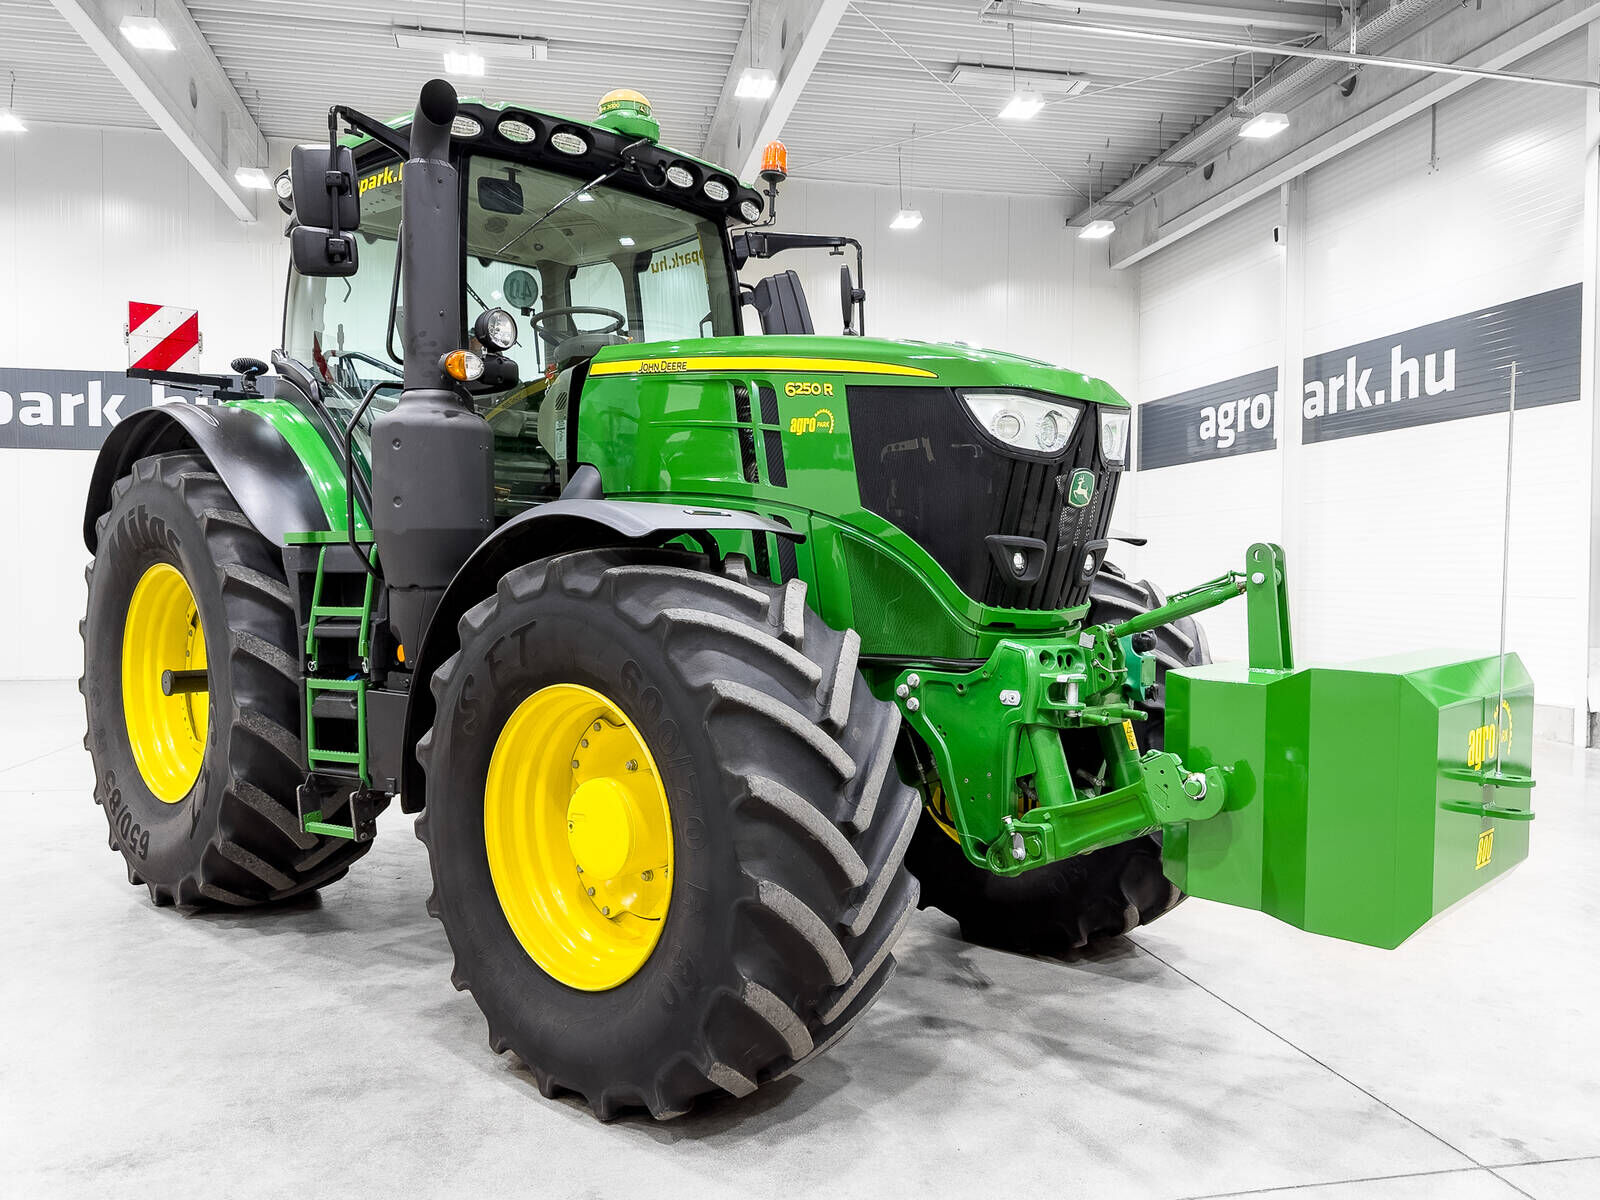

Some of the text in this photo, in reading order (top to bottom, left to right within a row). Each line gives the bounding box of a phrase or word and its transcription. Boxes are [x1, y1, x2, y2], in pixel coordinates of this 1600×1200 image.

[358, 162, 404, 198] park.
[639, 360, 688, 373] JOHN DEERE
[784, 382, 834, 397] 6250 R
[790, 417, 817, 435] agro
[1467, 723, 1496, 771] agro
